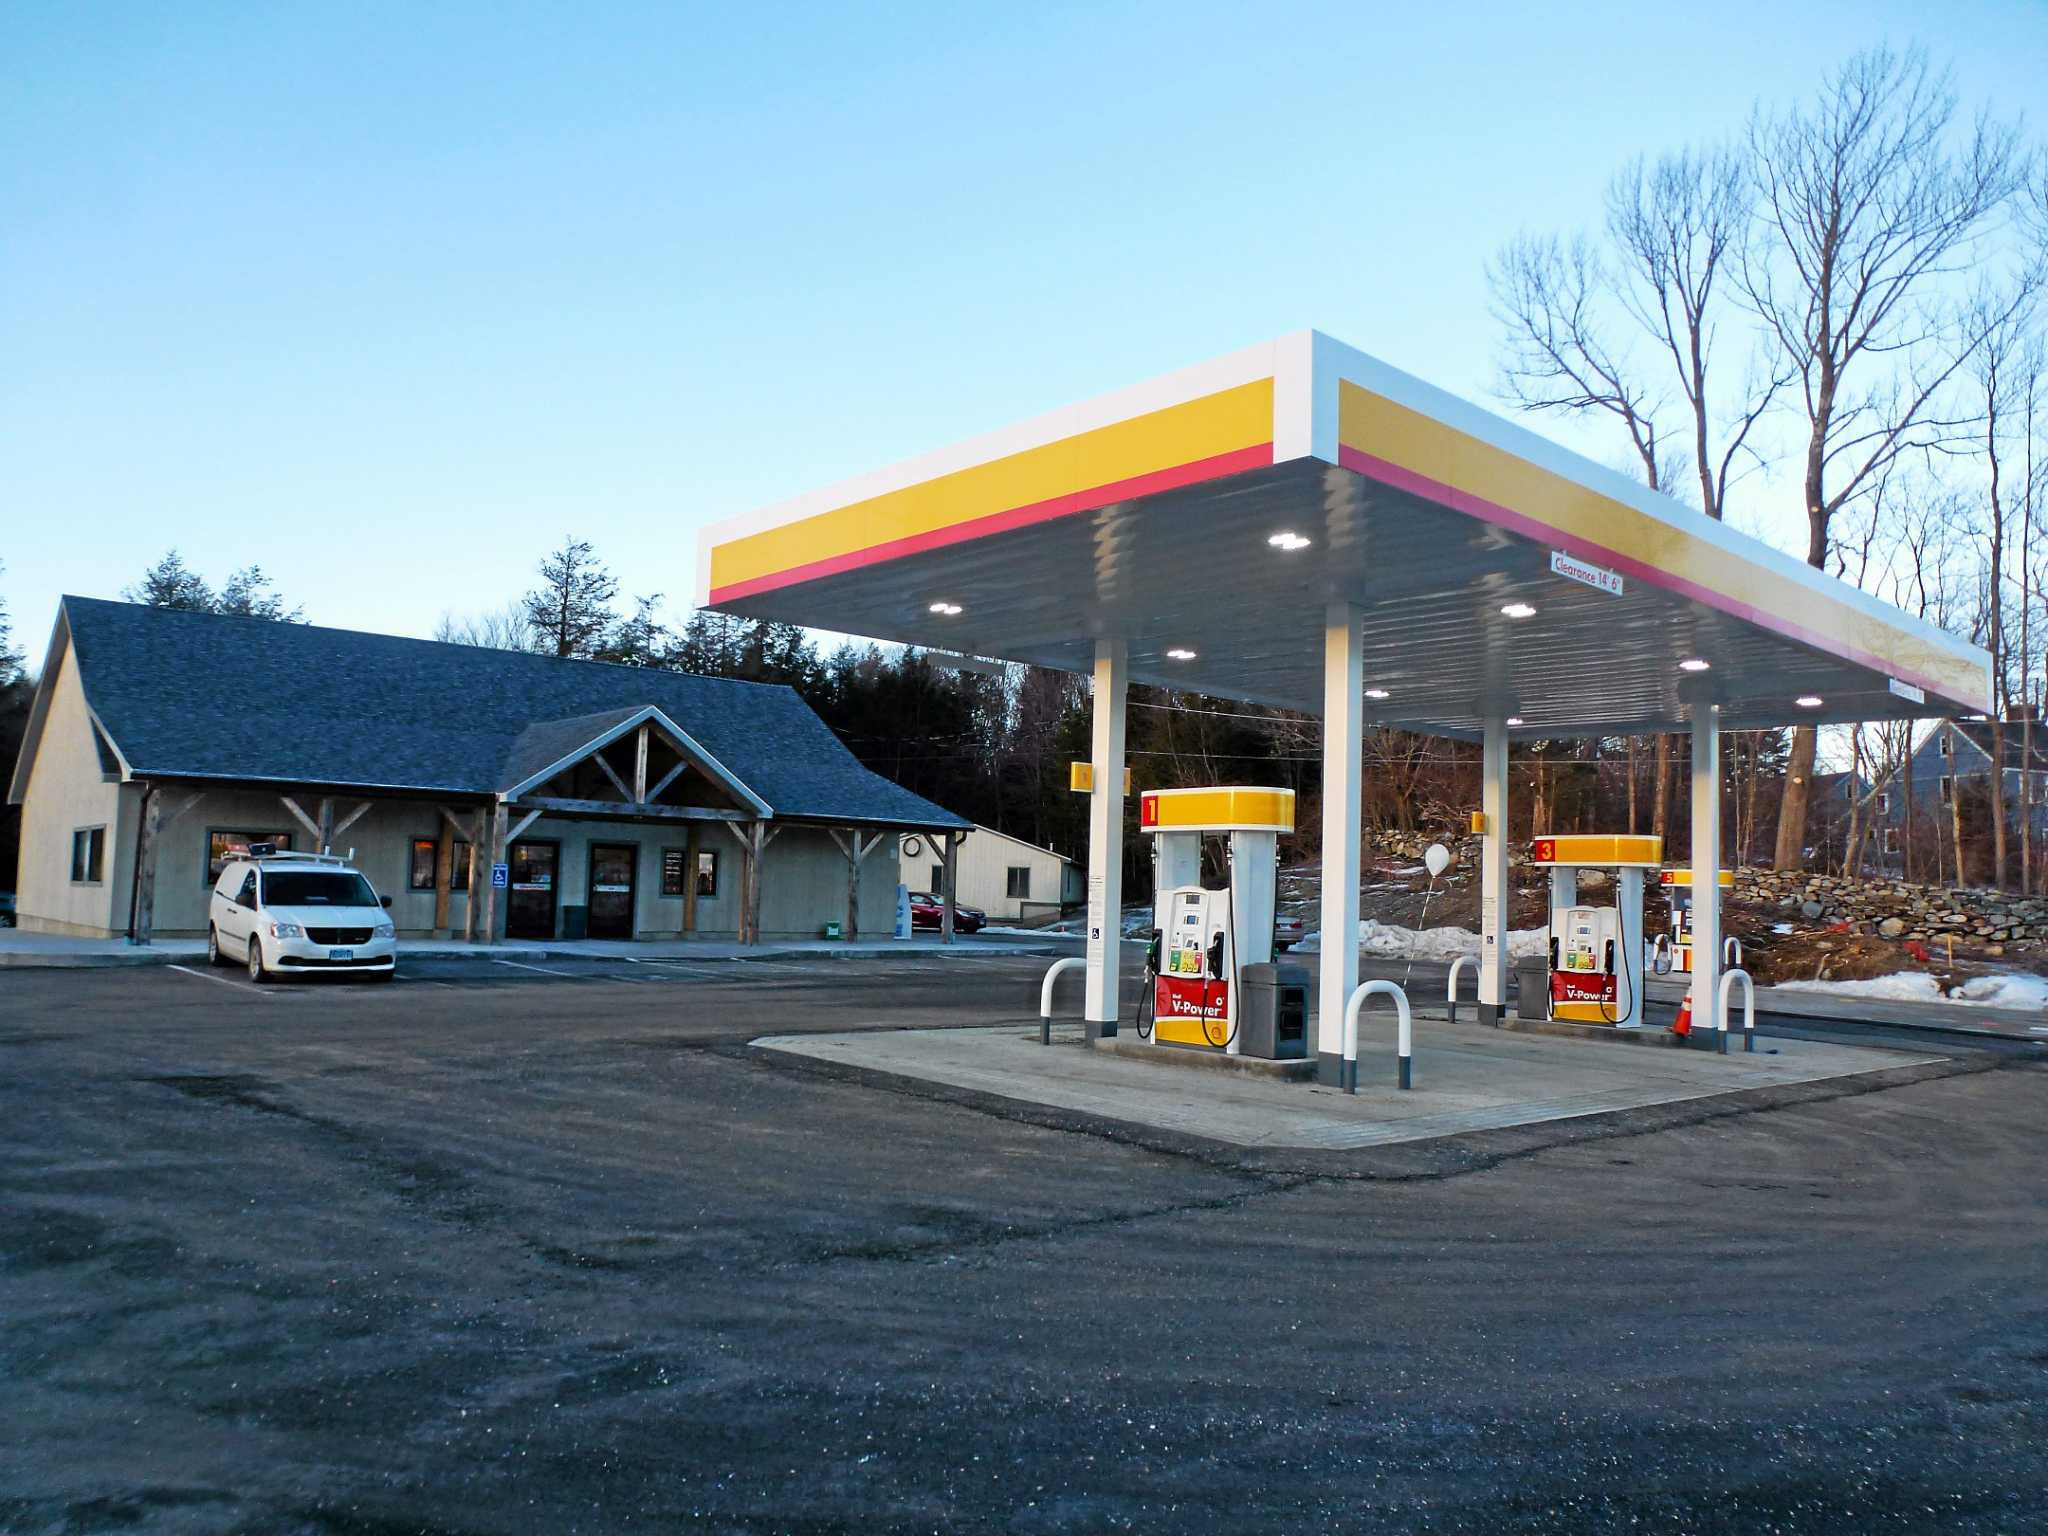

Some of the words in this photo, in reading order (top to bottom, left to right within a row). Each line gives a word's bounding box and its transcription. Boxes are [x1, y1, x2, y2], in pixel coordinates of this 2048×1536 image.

[1555, 557, 1596, 584] Clearance
[1148, 799, 1156, 822] 1
[1541, 842, 1552, 860] 3
